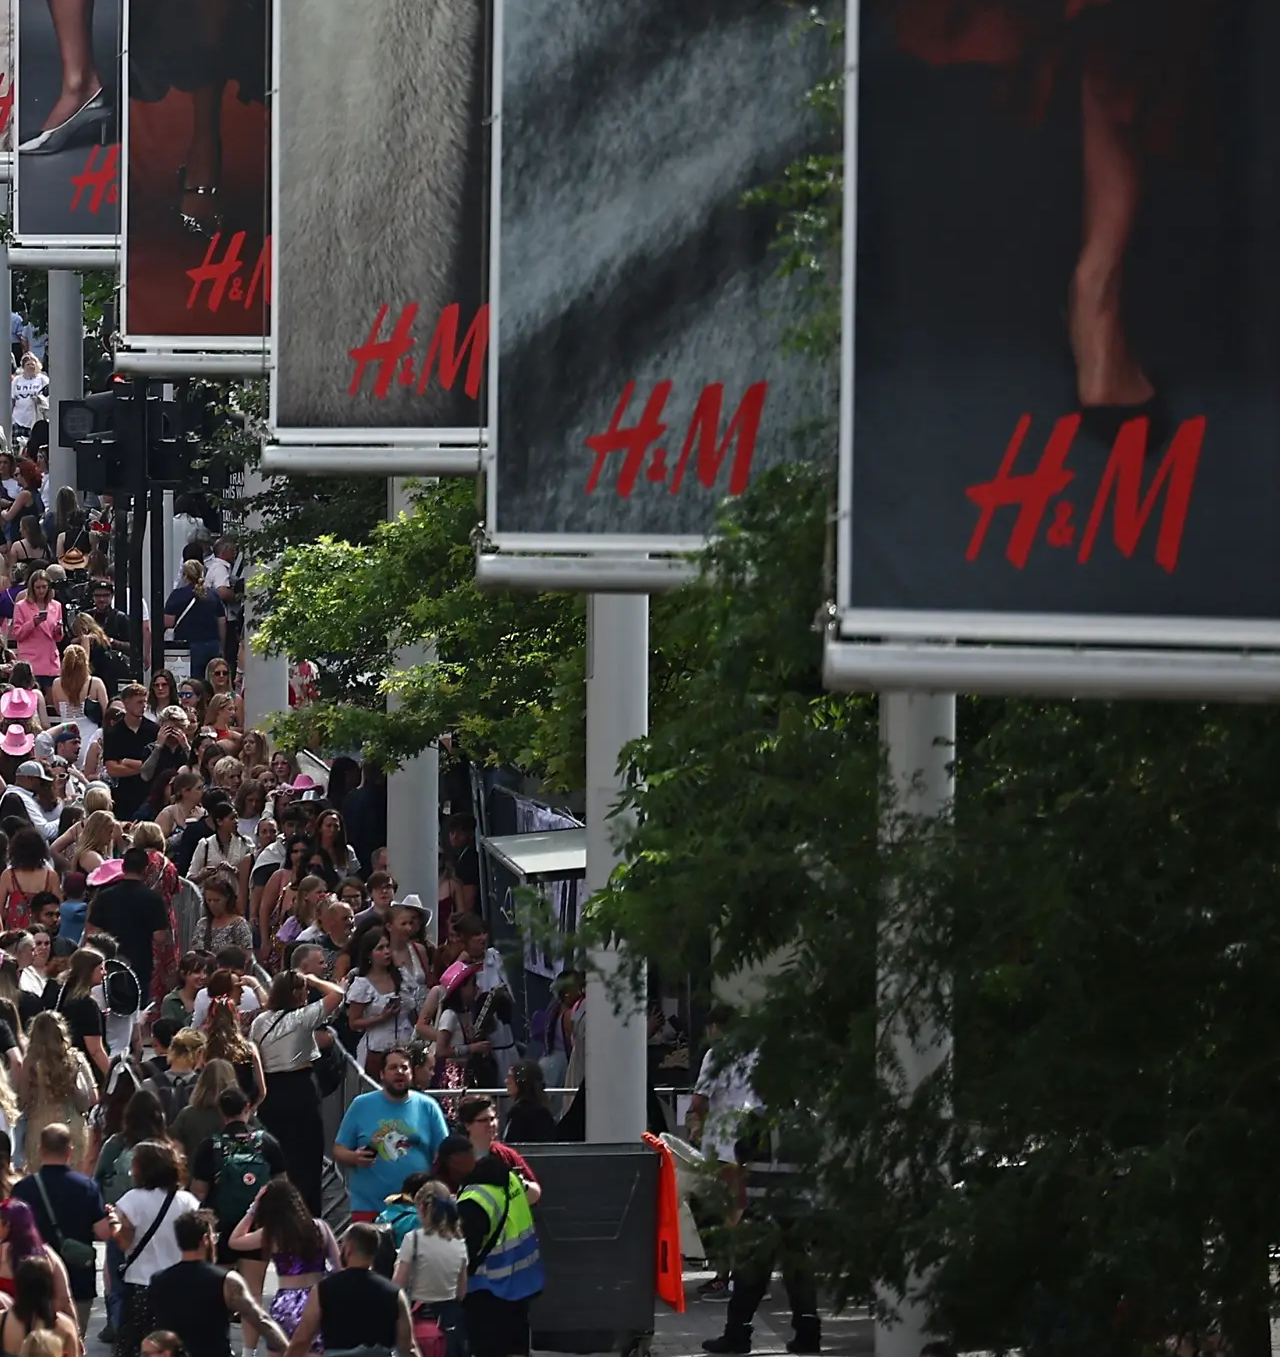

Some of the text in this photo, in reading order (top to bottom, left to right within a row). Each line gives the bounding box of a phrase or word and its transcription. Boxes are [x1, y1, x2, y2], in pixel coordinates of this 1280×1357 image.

[348, 301, 489, 399] H&M
[584, 379, 768, 497] H&M
[964, 413, 1207, 572] H&M
